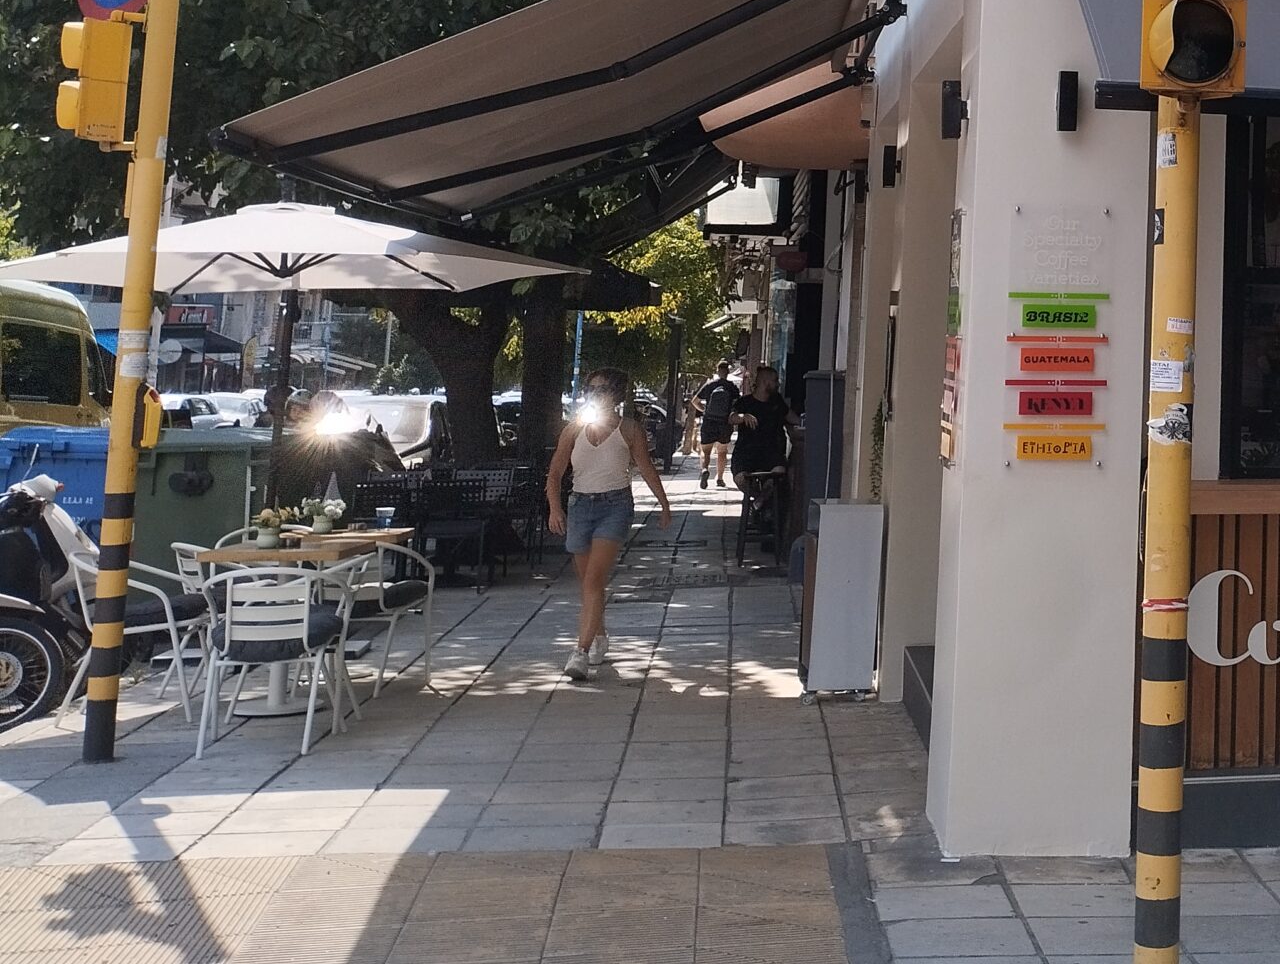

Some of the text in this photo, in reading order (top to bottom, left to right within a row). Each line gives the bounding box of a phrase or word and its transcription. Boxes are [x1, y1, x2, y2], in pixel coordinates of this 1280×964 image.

[1023, 229, 1102, 251] Specialty
[1034, 249, 1089, 269] Coffee
[1026, 310, 1089, 324] BRASIL
[1023, 354, 1091, 365] GUATEMALA
[1027, 397, 1085, 414] KENYA
[1022, 441, 1087, 455] ETHIOPIA
